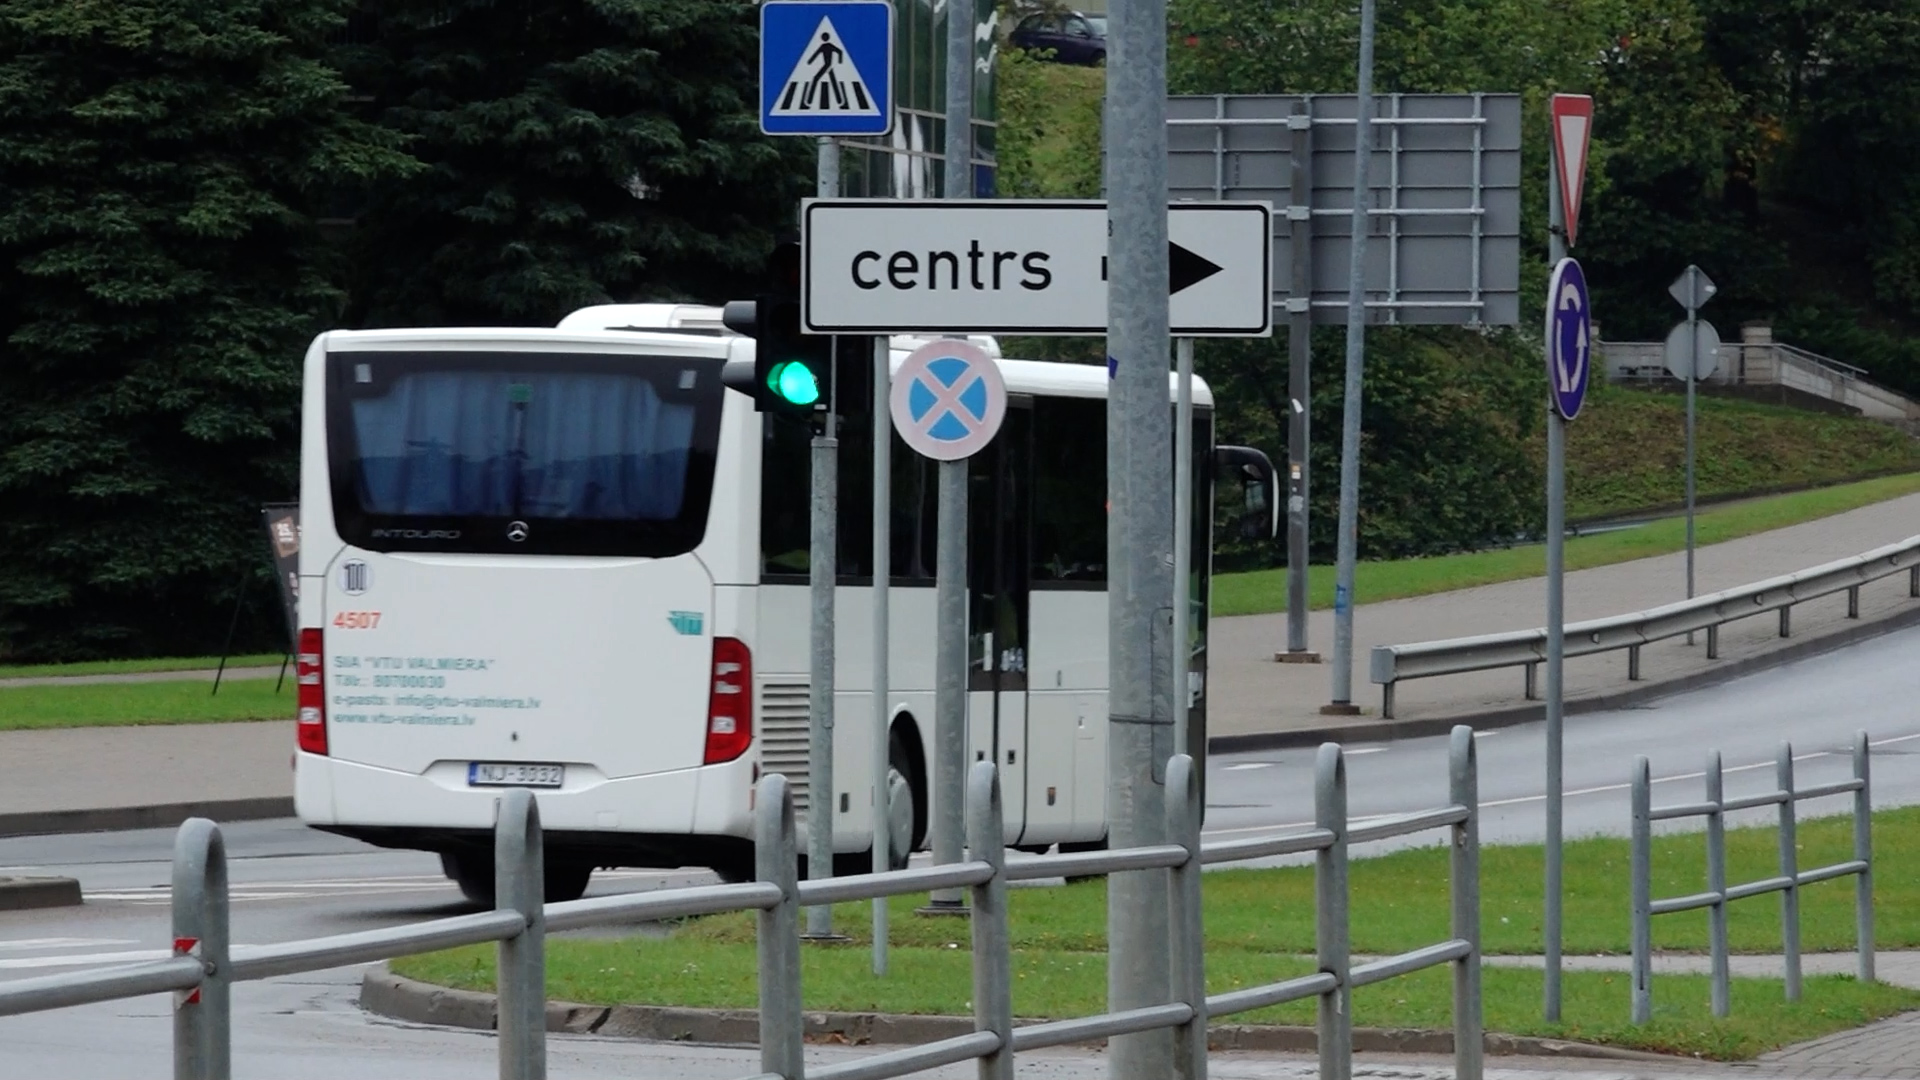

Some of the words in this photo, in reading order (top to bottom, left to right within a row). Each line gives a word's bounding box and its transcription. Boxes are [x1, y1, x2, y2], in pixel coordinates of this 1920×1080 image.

[851, 239, 1052, 291] centrs
[371, 529, 461, 539] INTOURO
[333, 612, 381, 629] 4507
[333, 655, 360, 669] SIA
